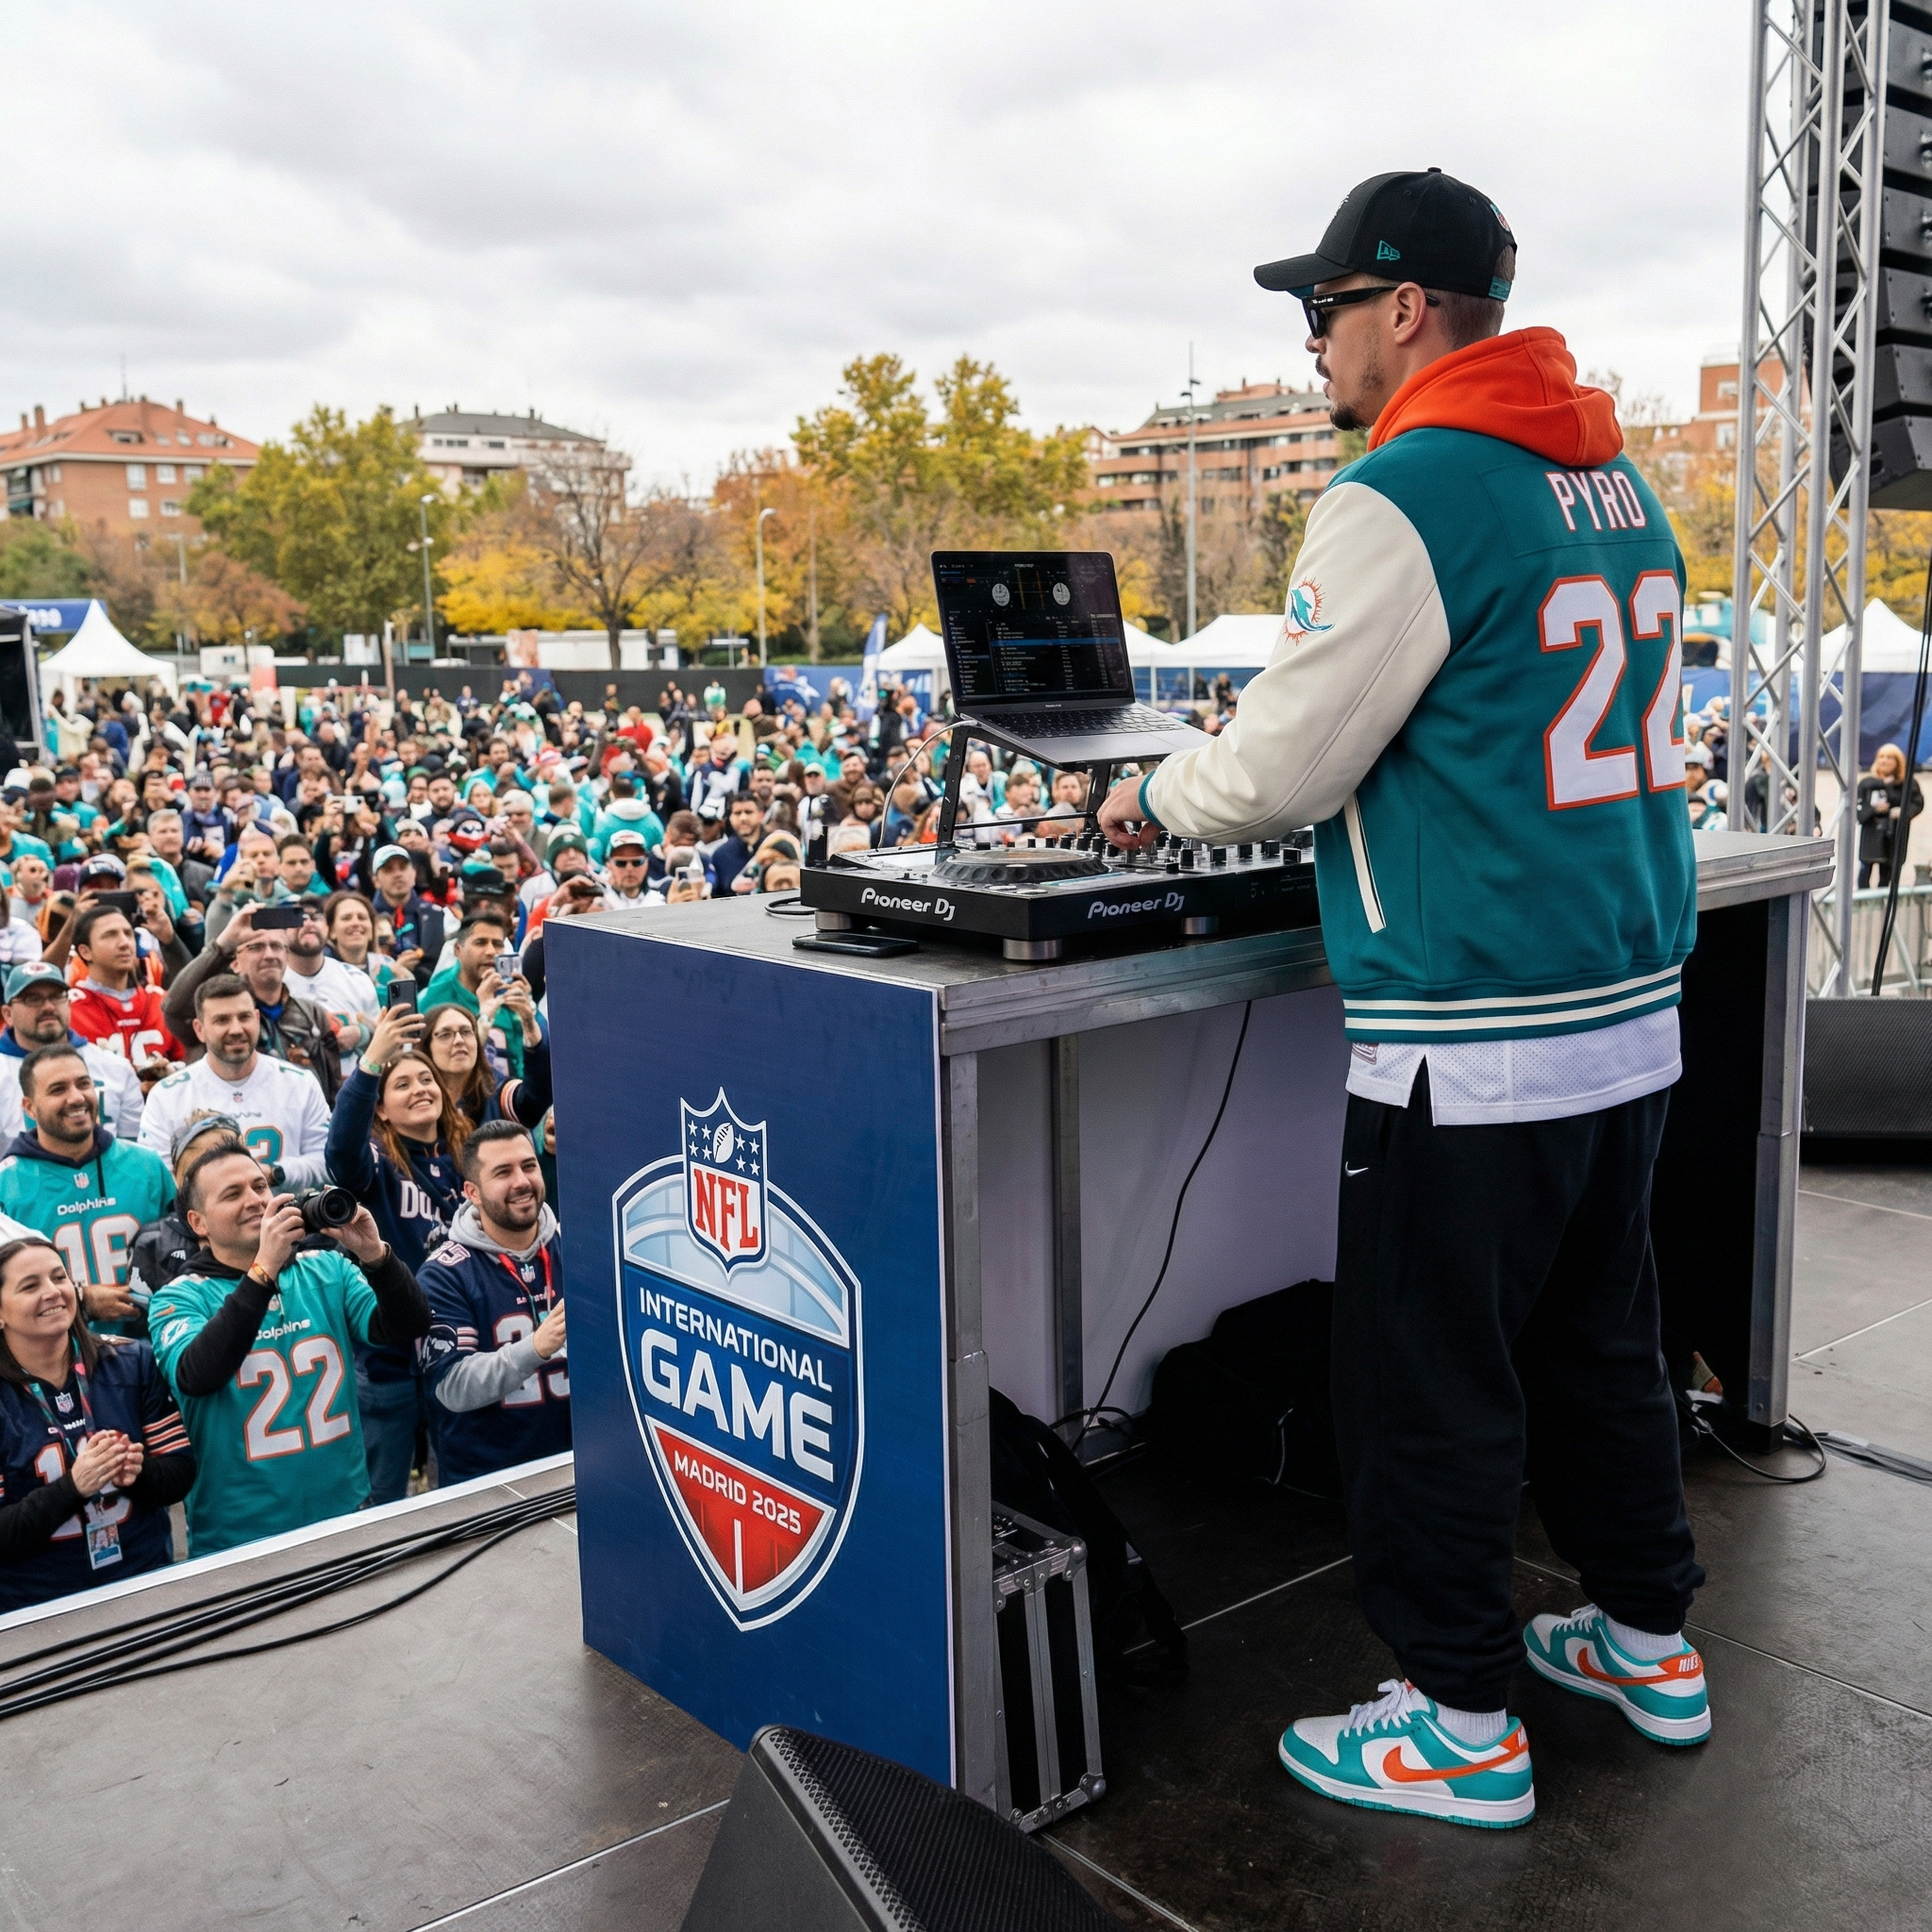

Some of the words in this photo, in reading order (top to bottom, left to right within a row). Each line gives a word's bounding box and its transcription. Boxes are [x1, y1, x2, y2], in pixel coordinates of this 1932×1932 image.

[1544, 470, 1647, 531] PYRO
[1538, 569, 1687, 811] 22
[860, 887, 931, 913] Pioneer
[1087, 897, 1161, 920] Pioneer
[693, 1167, 758, 1252] NFL
[640, 1287, 832, 1393] INTERNATIONAL
[236, 1333, 352, 1462] 22
[641, 1328, 834, 1483] GAME
[674, 1449, 746, 1506] MADRID
[751, 1490, 802, 1536] 2025
